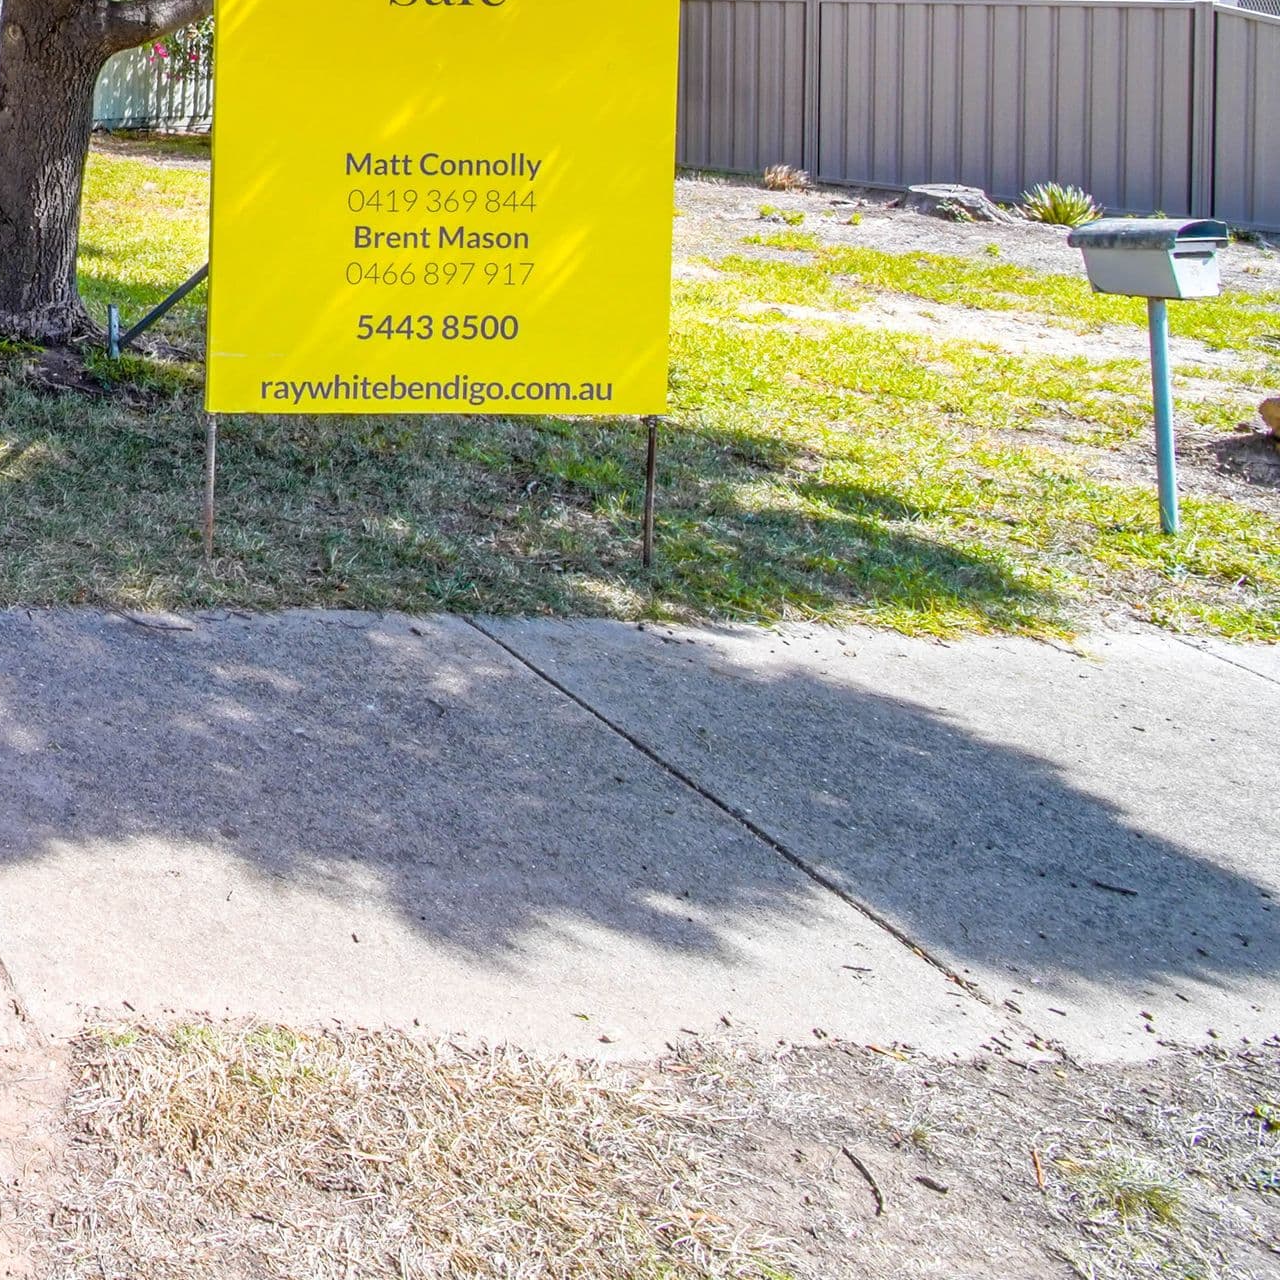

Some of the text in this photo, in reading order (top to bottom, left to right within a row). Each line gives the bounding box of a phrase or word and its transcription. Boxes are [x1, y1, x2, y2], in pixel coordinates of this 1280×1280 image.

[345, 152, 542, 181] Matt Connolly
[347, 189, 537, 213] 0419 369 844
[354, 225, 529, 249] Brent Mason
[345, 261, 535, 286] 0466 897 917
[356, 314, 519, 340] 5443 8500
[261, 374, 613, 405] raywhitebendigo.com.au
